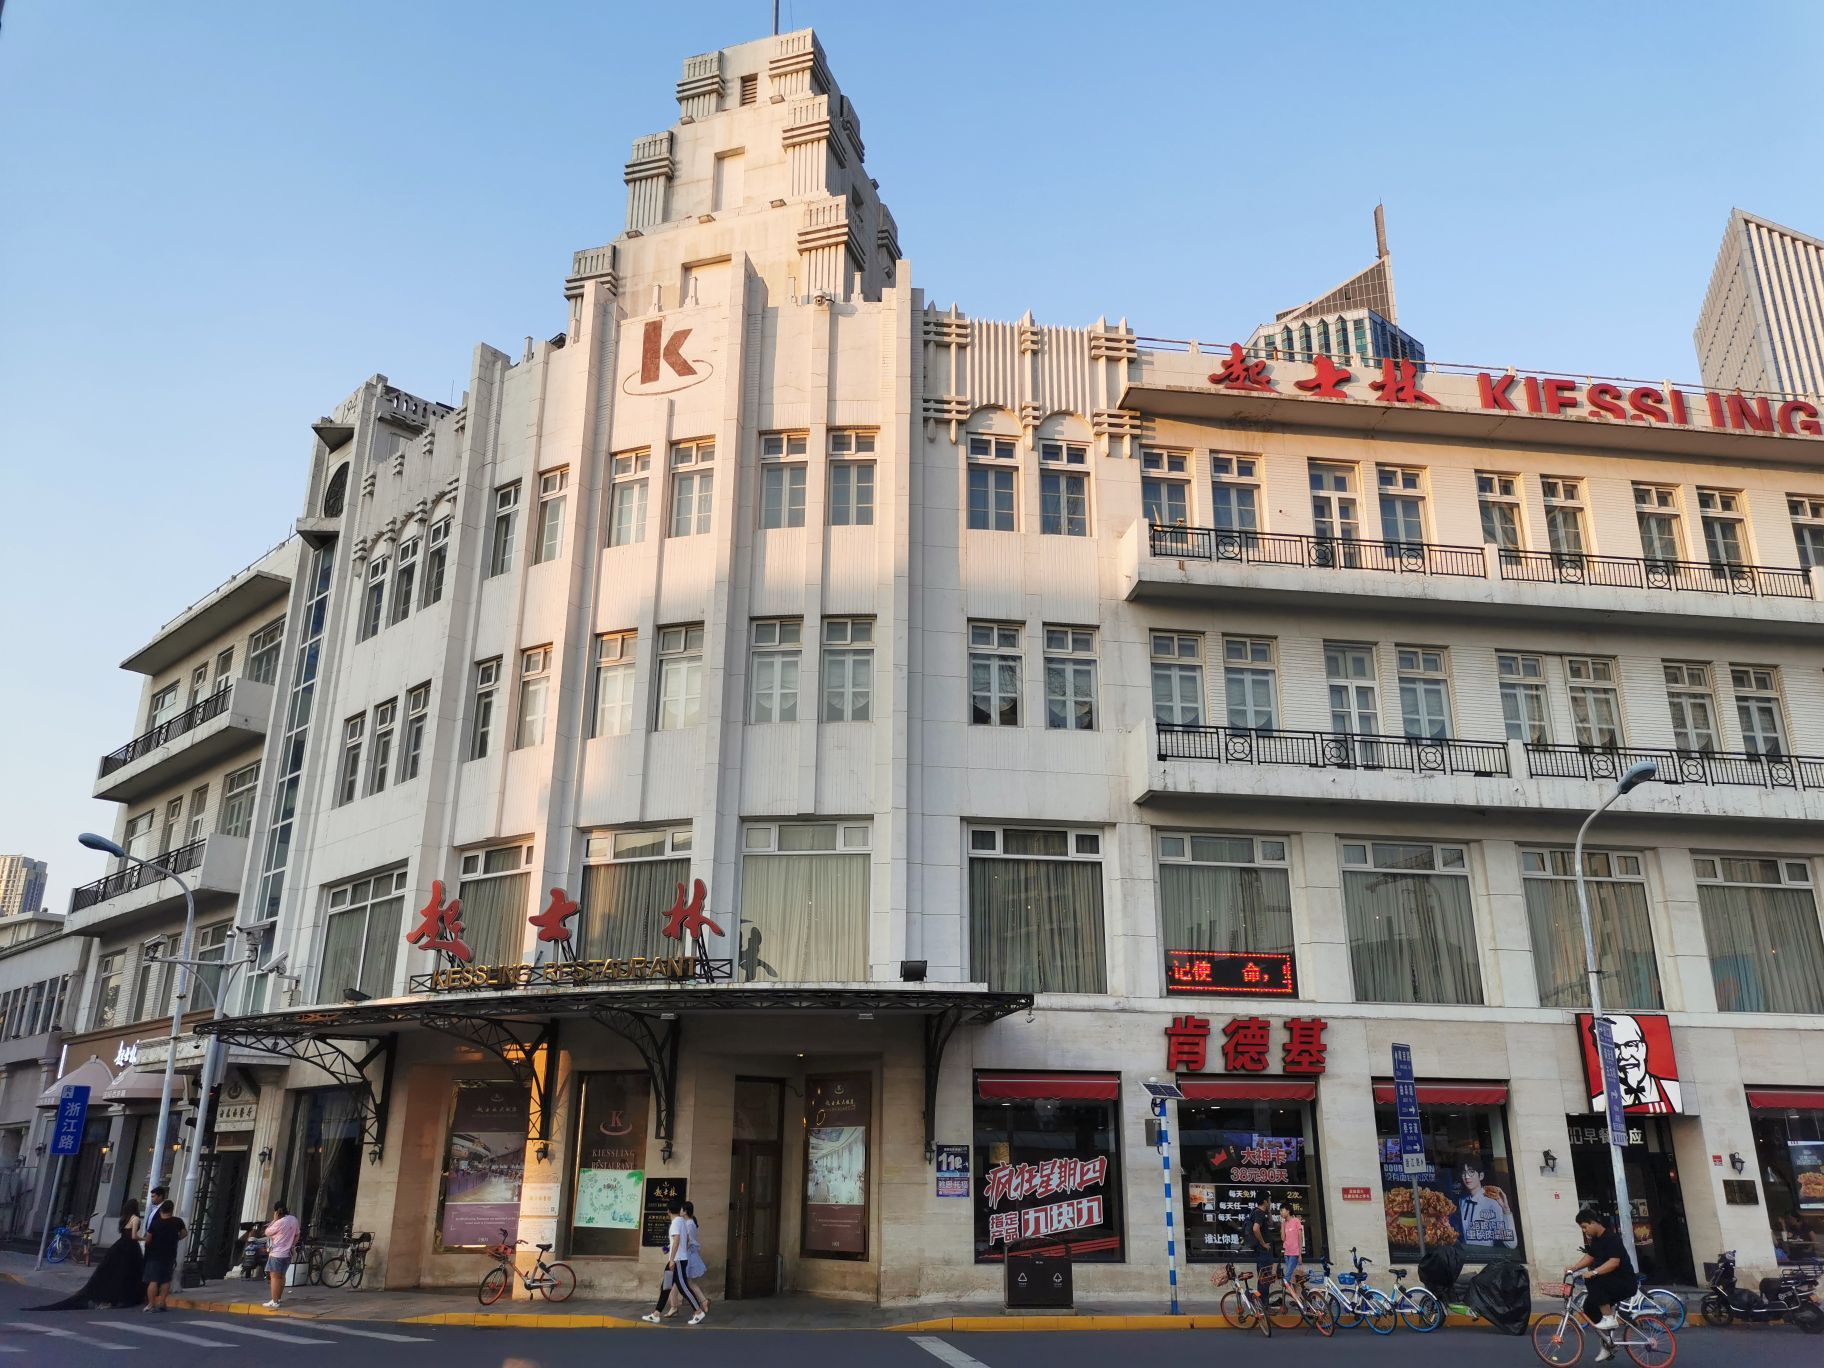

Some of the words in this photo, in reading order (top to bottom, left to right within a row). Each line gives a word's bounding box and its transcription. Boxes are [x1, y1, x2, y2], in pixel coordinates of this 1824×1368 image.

[640, 319, 698, 385] K
[543, 956, 701, 982] RESTAURANT
[1165, 1014, 1328, 1074] 肯德基
[57, 1101, 81, 1150] 浙江路
[1241, 1147, 1287, 1165] 大神卡
[984, 1156, 1108, 1210] 疯狂星期四
[1230, 1167, 1289, 1183] 38元90天
[990, 1212, 1018, 1228] 指定
[1022, 1195, 1103, 1238] 九块九
[990, 1226, 1019, 1245] 产品
[1204, 1234, 1244, 1244] 谁让你是
